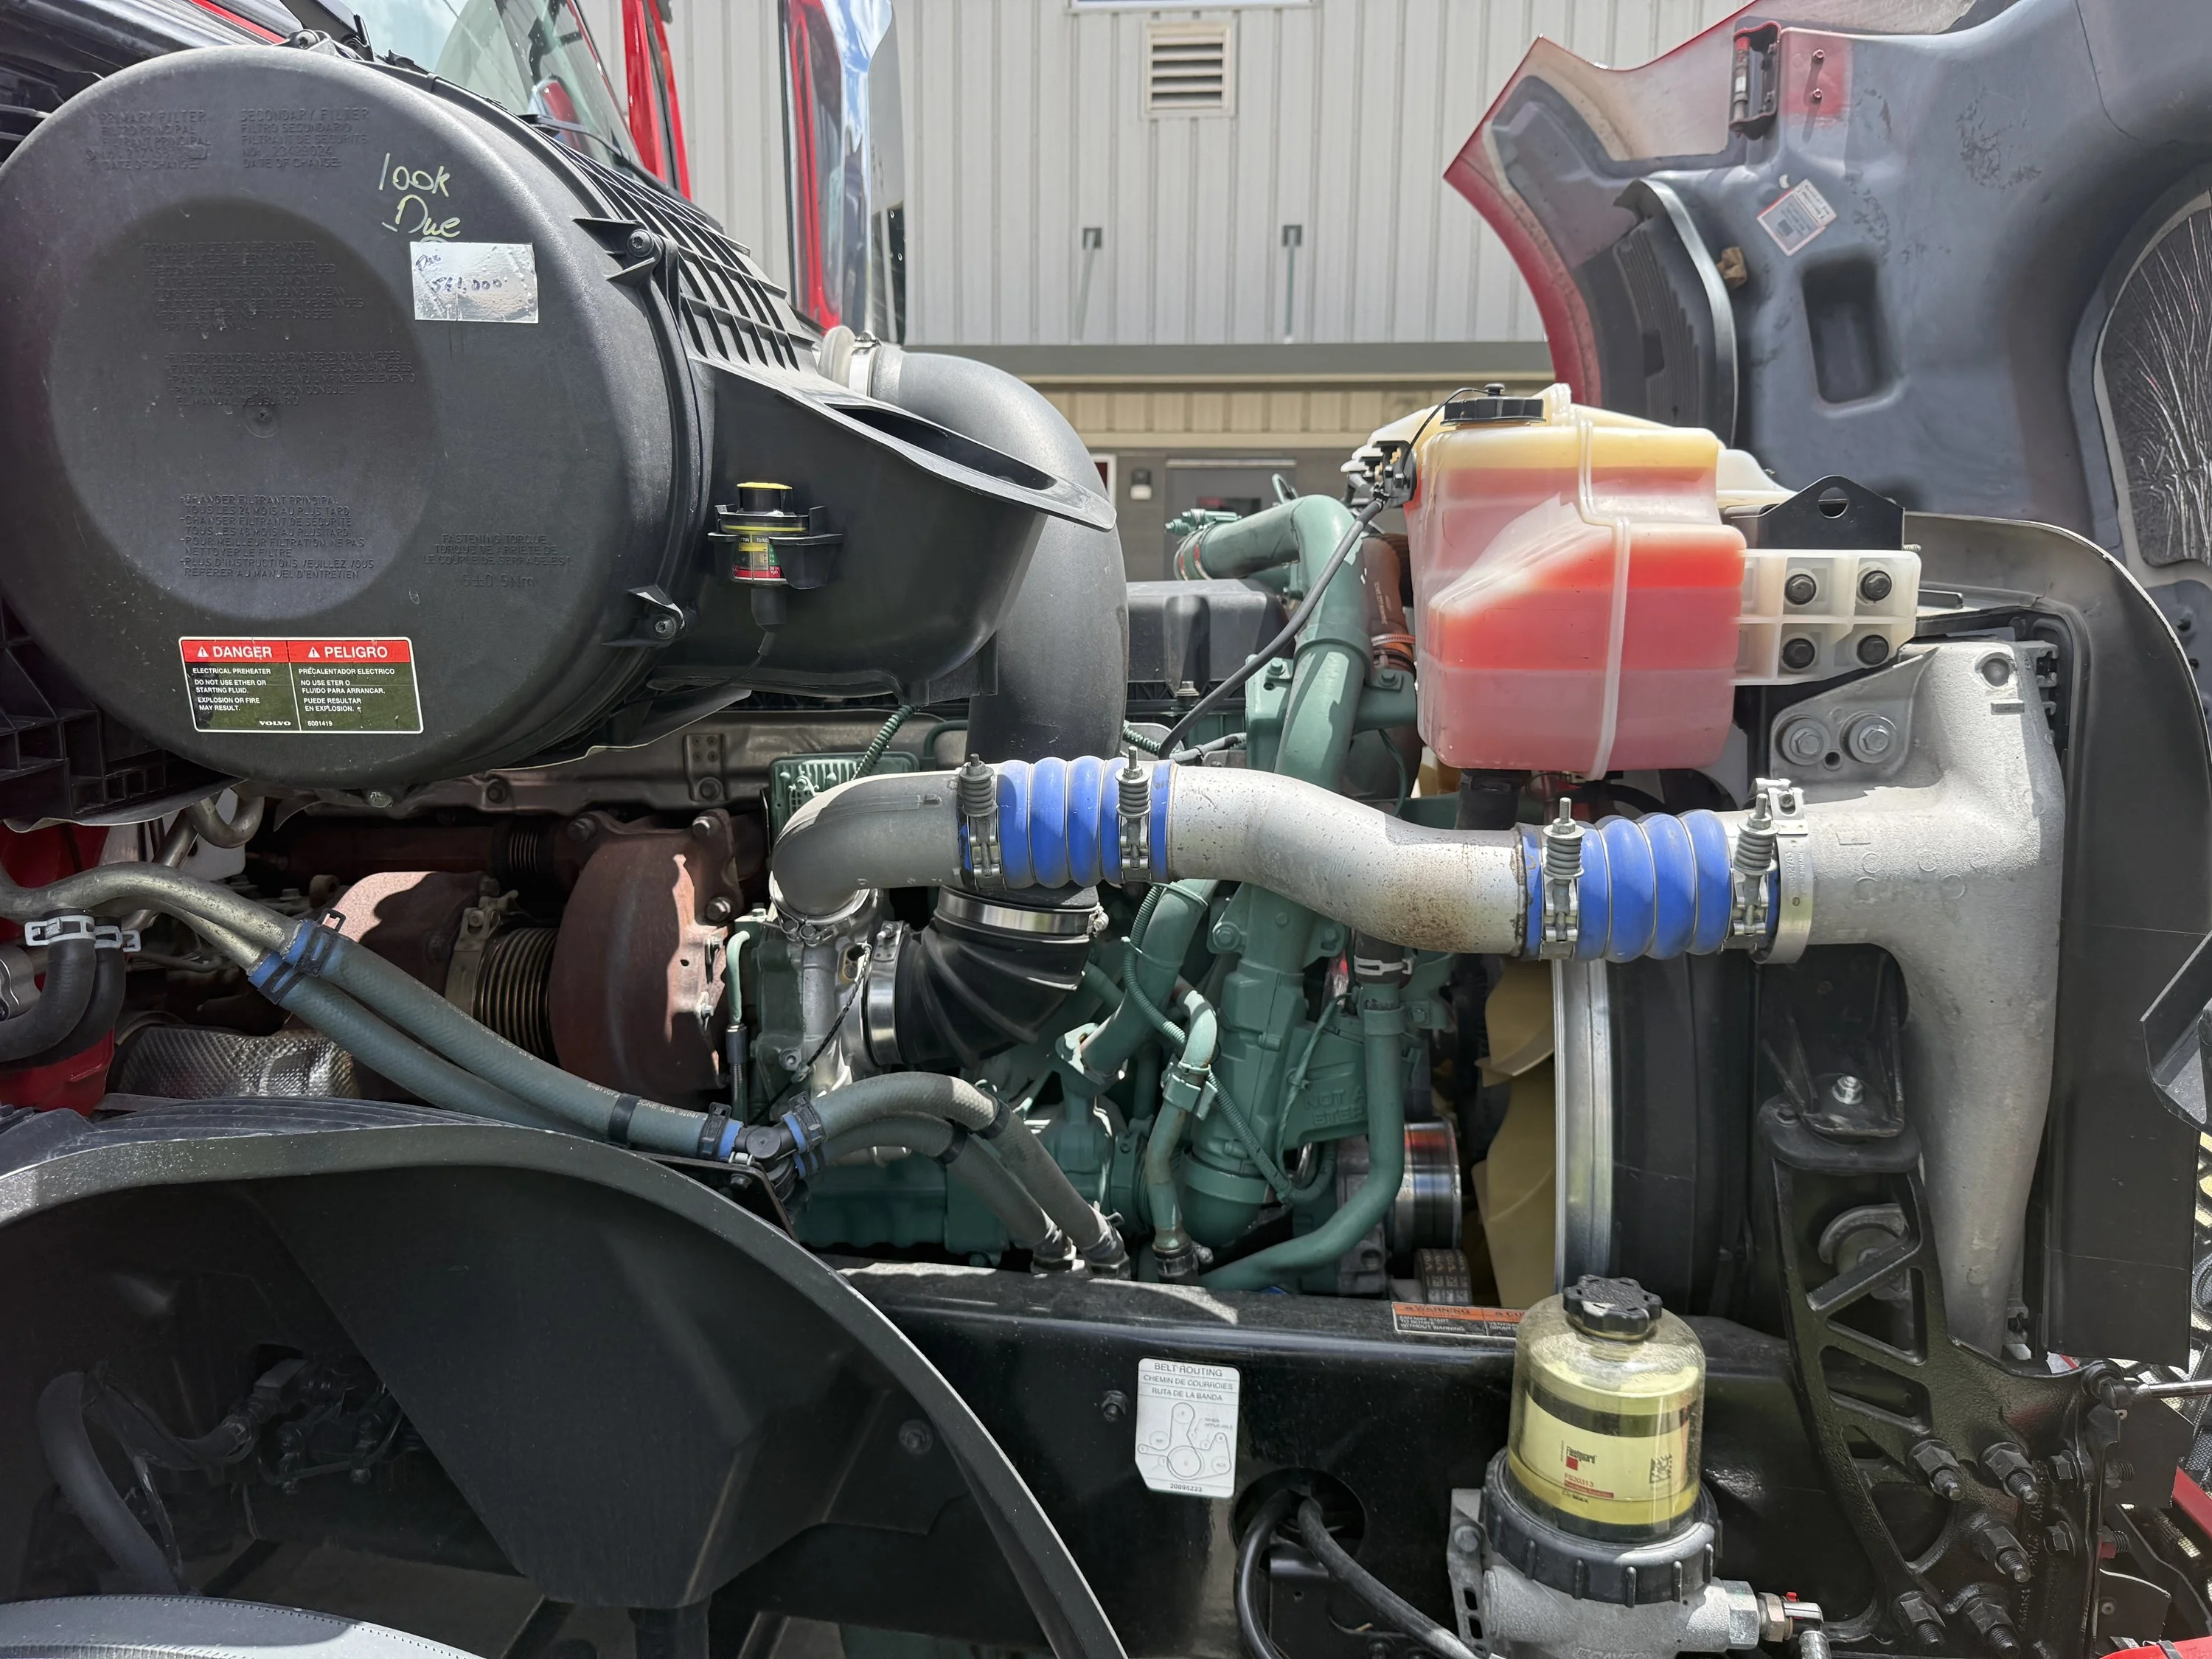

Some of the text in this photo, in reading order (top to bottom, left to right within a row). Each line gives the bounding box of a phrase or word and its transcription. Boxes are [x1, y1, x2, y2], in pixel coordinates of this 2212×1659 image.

[241, 107, 370, 122] SECONDARY FILTER
[241, 123, 279, 133] FILTRO
[239, 495, 287, 505] FILTRANT
[290, 495, 341, 505] PRINCIPAL
[185, 504, 213, 515] TOUS
[216, 505, 236, 515] LES
[253, 506, 279, 516] MOIS
[282, 507, 295, 516] AU
[297, 507, 322, 516] PLUS
[324, 506, 351, 516] TARD
[238, 516, 286, 526] FILTRANT
[290, 516, 303, 526] DE
[185, 526, 214, 536] TOUS
[215, 526, 236, 536] LES
[253, 527, 278, 537] MOIS
[282, 527, 294, 537] AU
[297, 527, 322, 538] PLUS
[324, 527, 349, 537] TARD
[217, 537, 267, 547] MEILLEUR
[331, 538, 344, 548] NE
[346, 538, 366, 548] PAS
[442, 533, 549, 544] FASTENING TORQUE
[185, 546, 293, 557] NETTOYER LE FILTRE
[434, 544, 477, 554] TORQUE
[479, 544, 493, 554] DE
[302, 559, 347, 568] VEUILLEZ
[349, 559, 375, 568] VOUS
[422, 554, 571, 566] LE COUPLE DE SERRAGE EST
[236, 568, 360, 580] AU MANUEL D'ENTRETIEN
[213, 646, 273, 658] DANGER
[324, 646, 388, 658] PELIGRO
[1302, 1085, 1366, 1111] NOT A
[1312, 1105, 1365, 1125] STEP
[1415, 1305, 1470, 1315] WARNING
[1154, 1362, 1223, 1377] BELT ROUTING
[1143, 1374, 1173, 1384] CHEMIN
[1187, 1379, 1234, 1391] COURROIES
[1152, 1387, 1172, 1396] RUTA
[1197, 1392, 1223, 1402] BANDA
[1566, 1445, 1596, 1464] Fleetguard
[1564, 1472, 1594, 1487] FS20313
